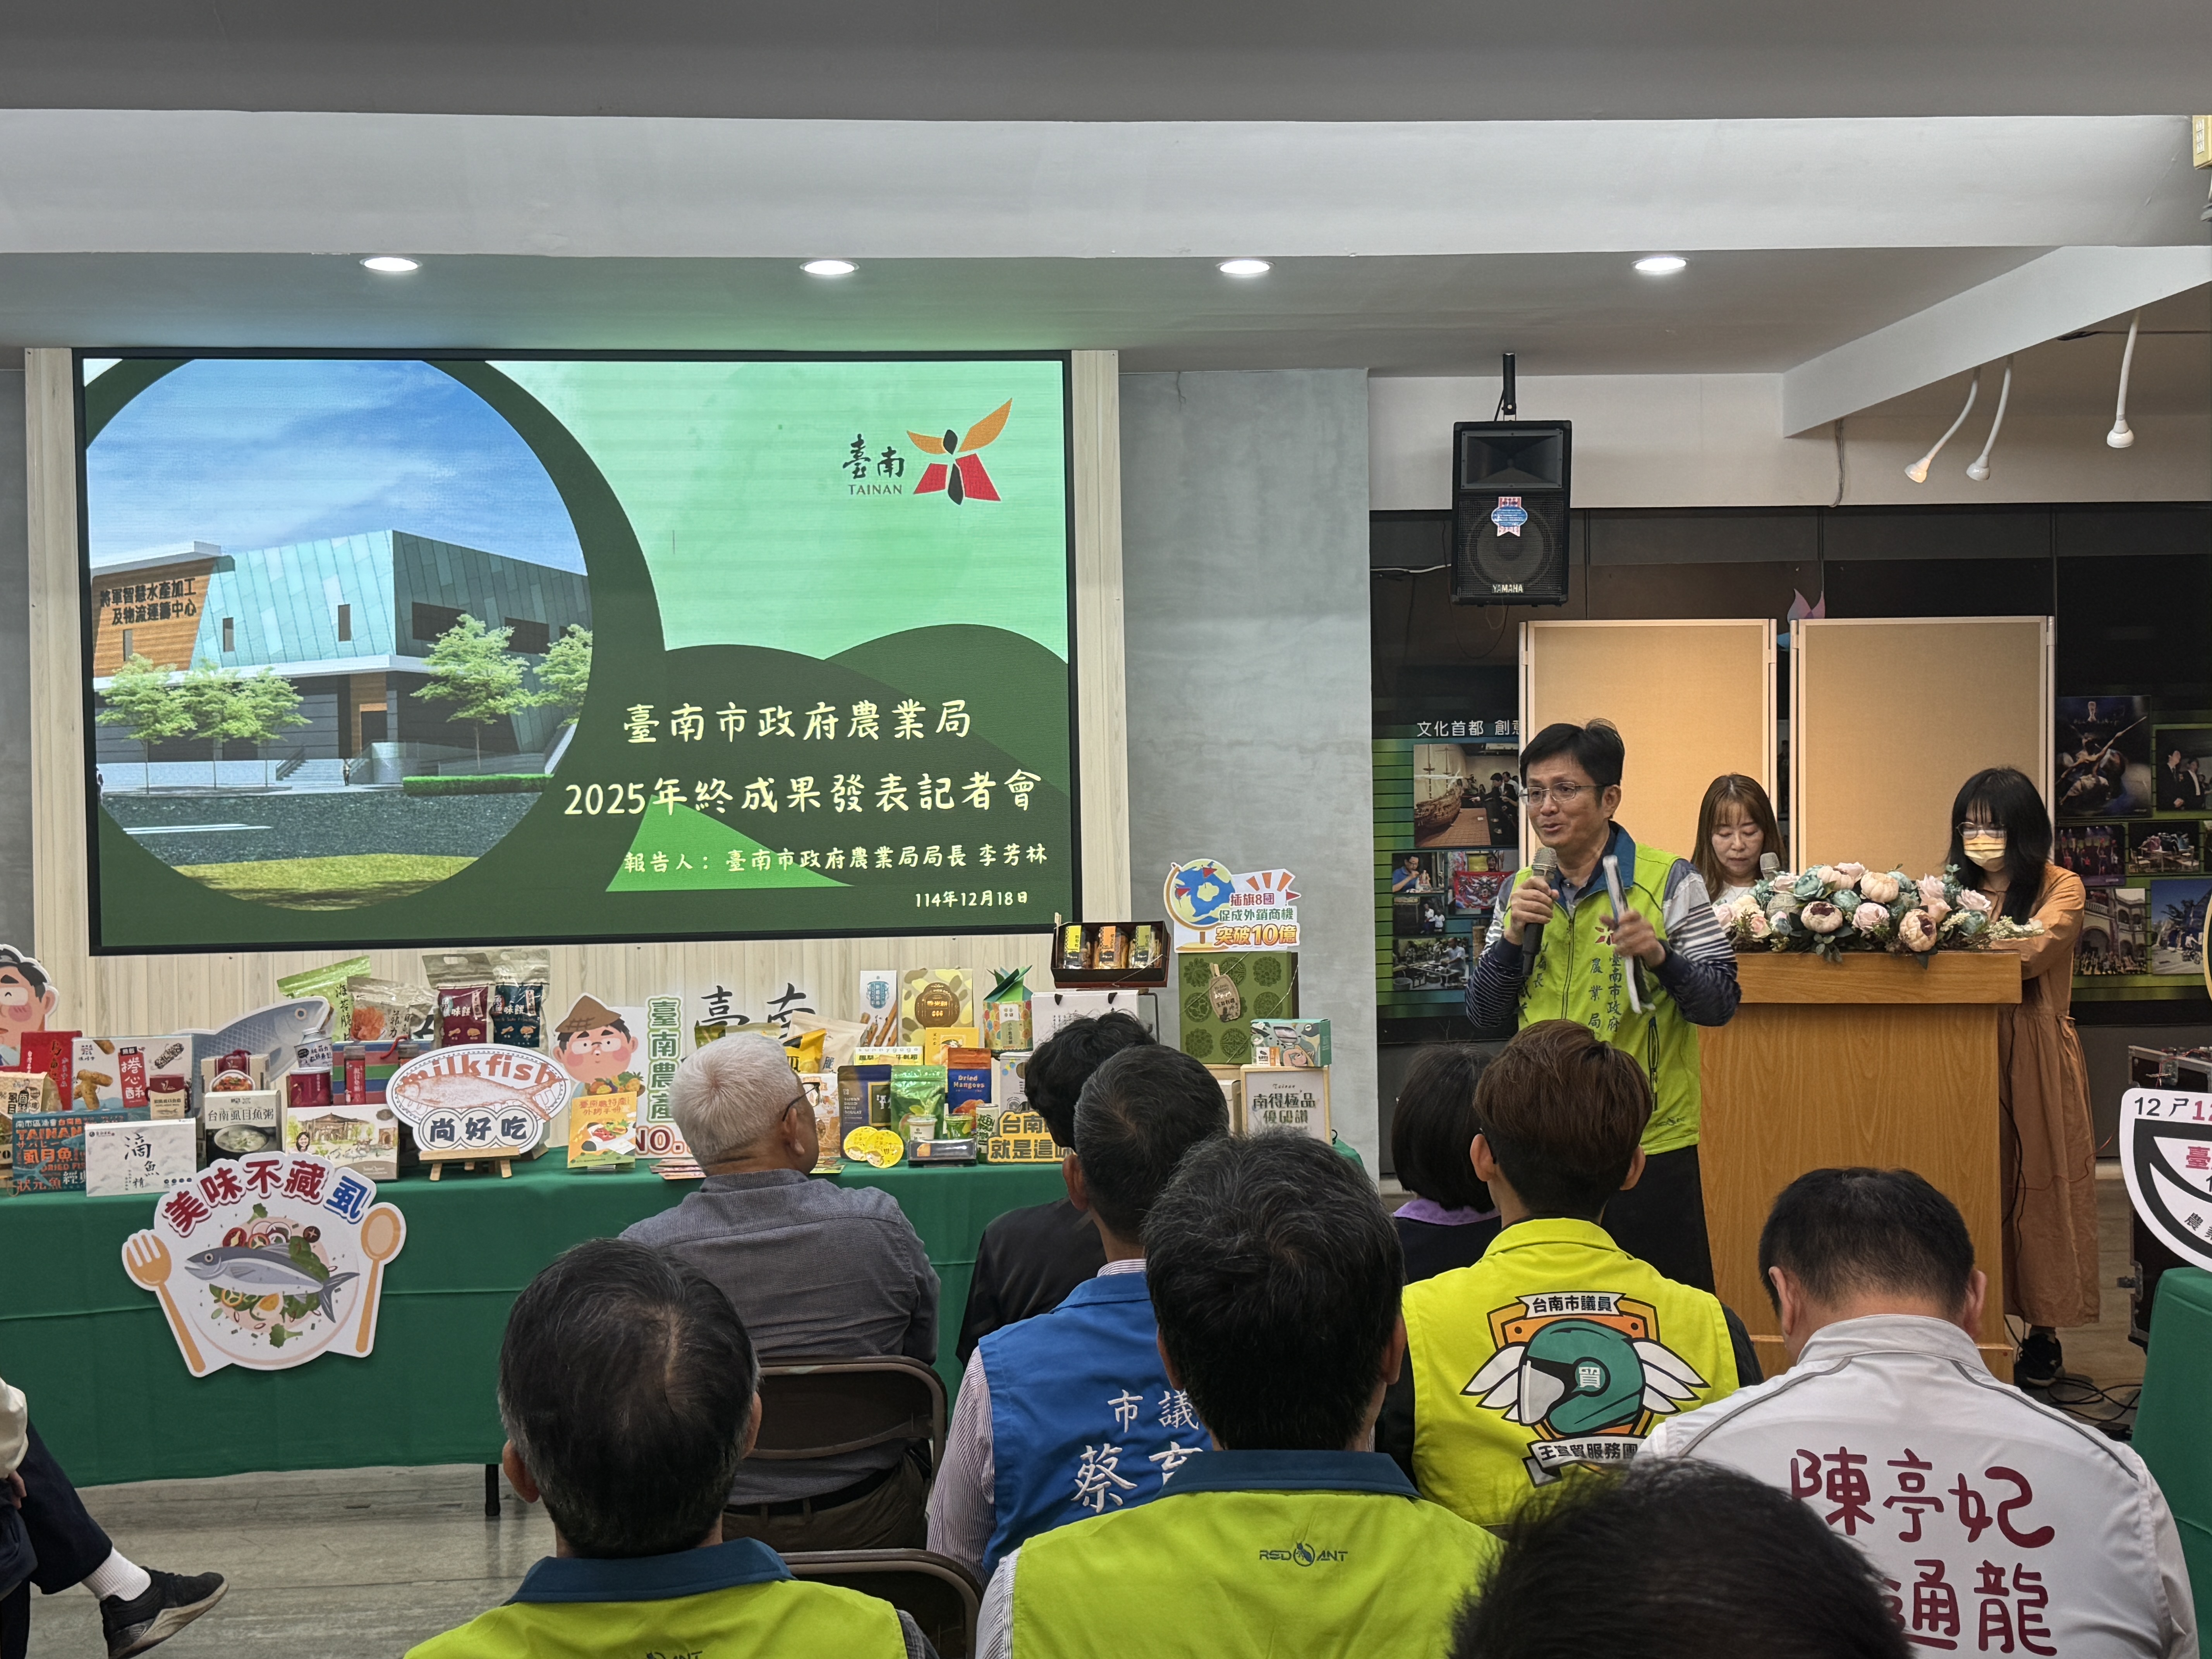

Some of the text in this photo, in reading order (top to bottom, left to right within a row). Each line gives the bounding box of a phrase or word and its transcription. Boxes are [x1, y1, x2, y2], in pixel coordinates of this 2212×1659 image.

[843, 434, 905, 479] 臺南
[848, 484, 902, 495] TAINAN
[100, 578, 196, 607] 將軍智慧水產加工
[1492, 584, 1523, 593] YAMAHA
[112, 599, 197, 625] 及物流運籌中心
[624, 699, 970, 743] 臺南市政府農業局
[1417, 721, 1484, 737] 文化首都
[565, 769, 1041, 815] 2025年終成果發表記者會
[726, 845, 966, 872] 臺南市政府農業局局長
[979, 843, 1047, 866] 李芳林
[915, 890, 1028, 907] 114年12月18日
[1231, 893, 1274, 906] 插旗8國
[1219, 908, 1293, 921] 促成外銷商機
[1214, 924, 1297, 946] 突破10億
[1589, 957, 1603, 1029] 農業局
[1607, 953, 1622, 1033] 臺南市政府
[651, 1001, 677, 1119] 臺南農產
[1253, 1093, 1316, 1109] 南得極品
[208, 1108, 274, 1122] 台南虱目魚粥
[1003, 1114, 1050, 1134] 台南
[16, 1126, 82, 1140] TAINAN
[429, 1116, 527, 1142] 尚好吃
[23, 1147, 72, 1164] 虱目魚
[2186, 1146, 2212, 1170] 臺
[164, 1159, 368, 1234] 美味不藏虱
[1532, 1295, 1612, 1313] 台南市議員
[1578, 1367, 1601, 1388] 貿
[1791, 1446, 2055, 1548] 陳亭妃
[1317, 1550, 1348, 1562] ANT
